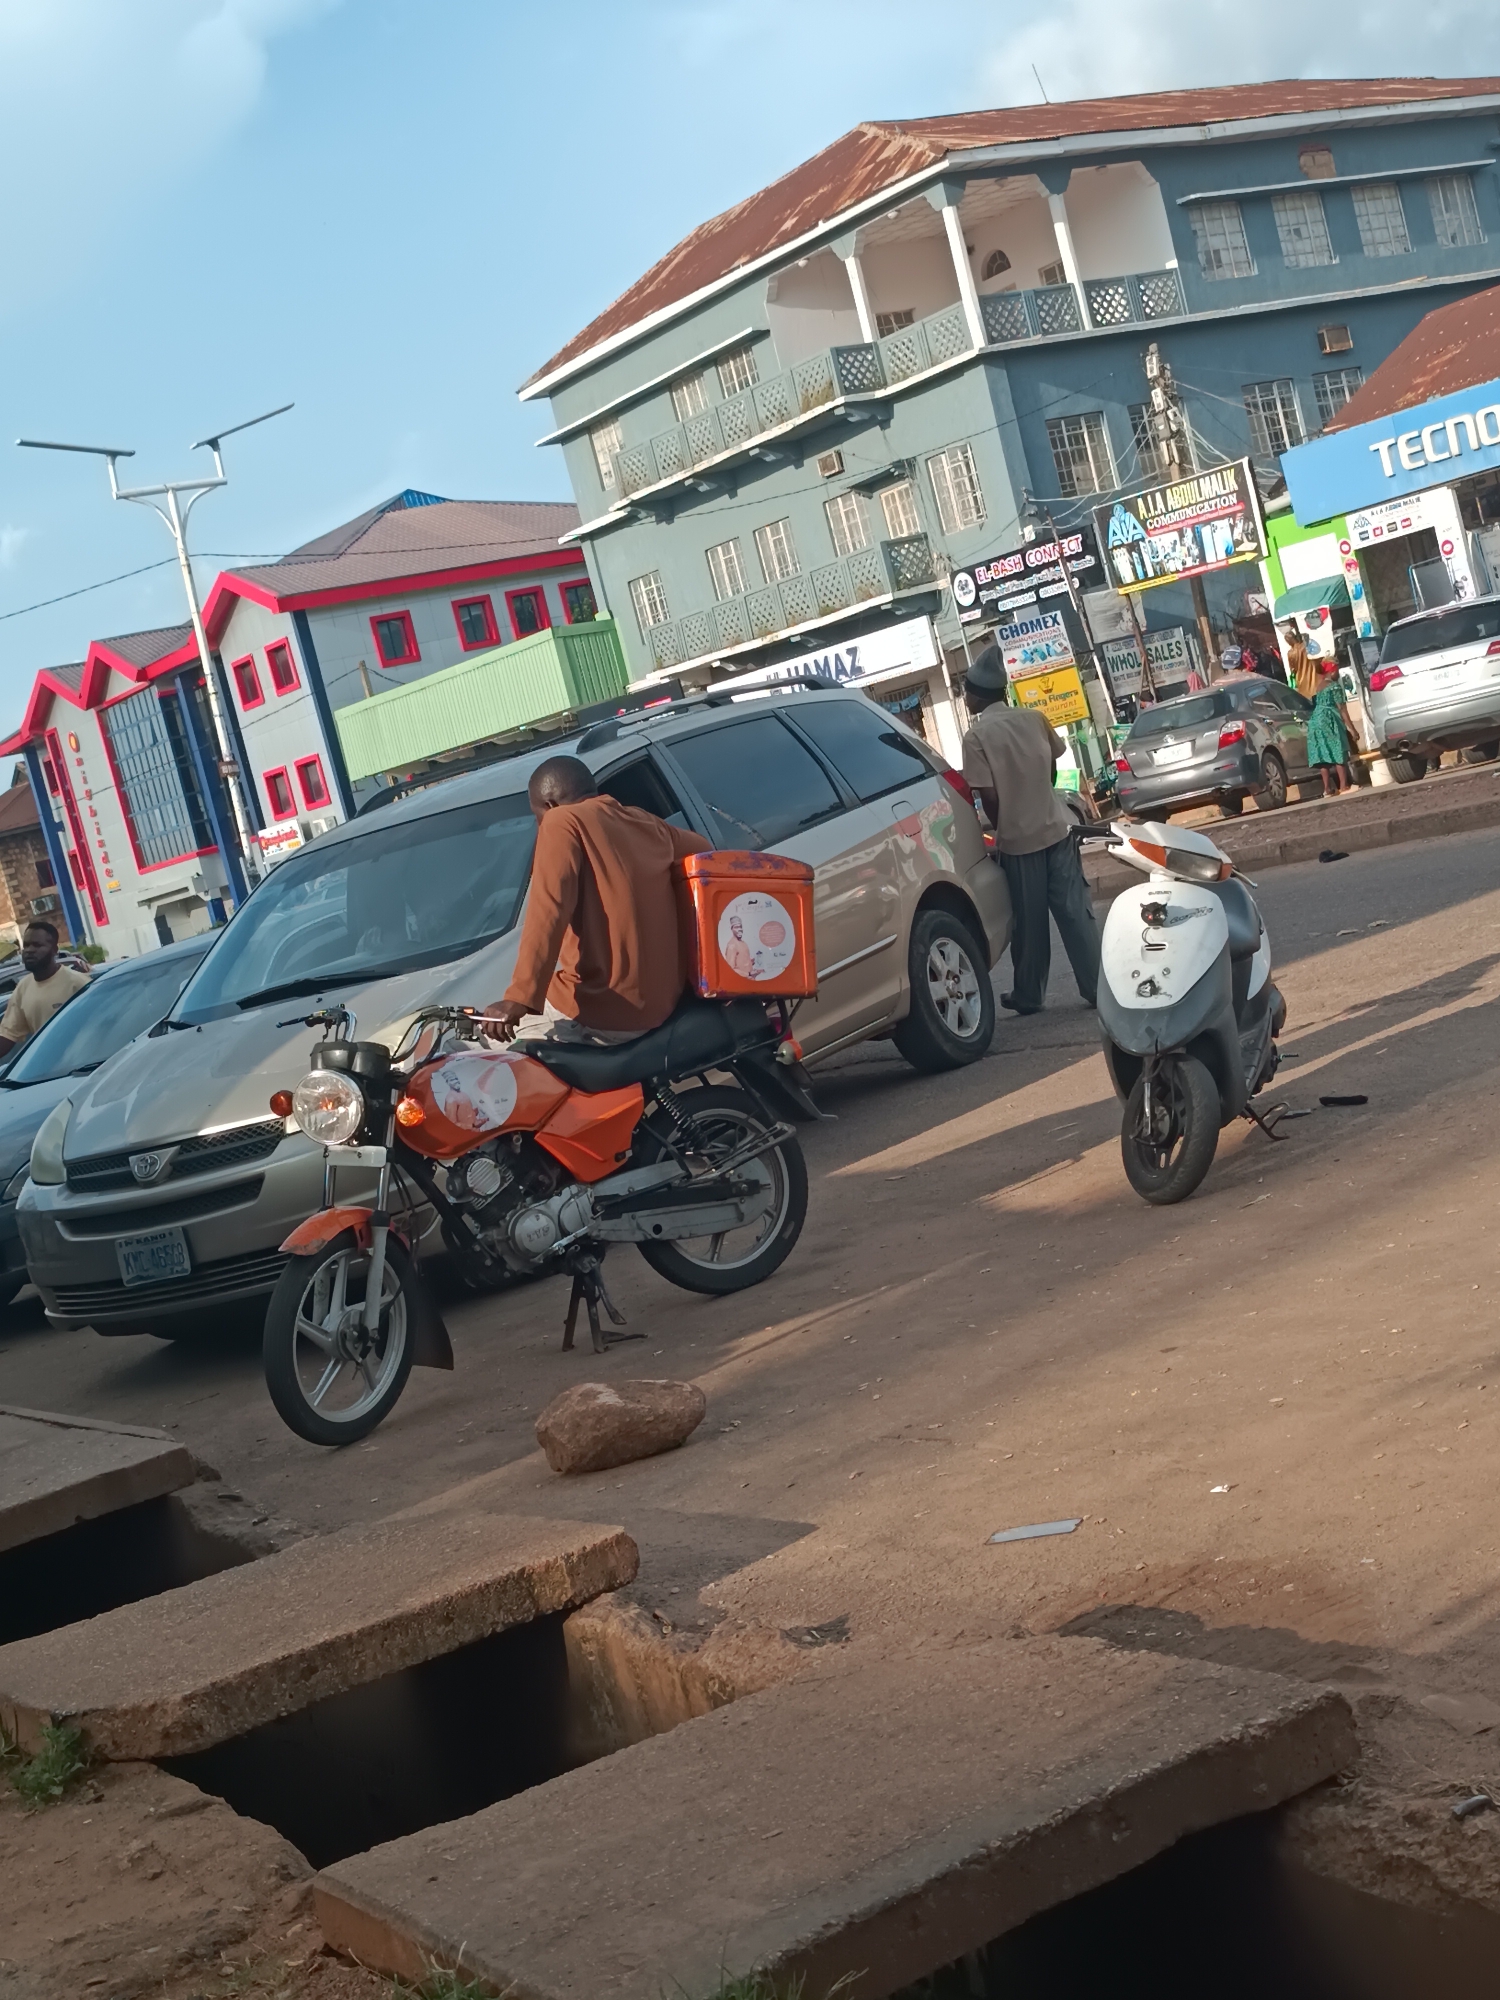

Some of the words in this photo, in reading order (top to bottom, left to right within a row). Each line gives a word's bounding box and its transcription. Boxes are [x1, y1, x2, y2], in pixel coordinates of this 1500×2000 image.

[1369, 404, 1500, 477] TECNO
[1166, 468, 1238, 511] ABDULMALIK
[1146, 493, 1237, 529] COMMUNICATION
[975, 554, 1024, 584] EL-BASH
[1026, 534, 1082, 567] CONNECT
[999, 613, 1061, 640] CHOMEX
[1107, 641, 1183, 673] WHOLSALES
[1043, 699, 1077, 715] staurant
